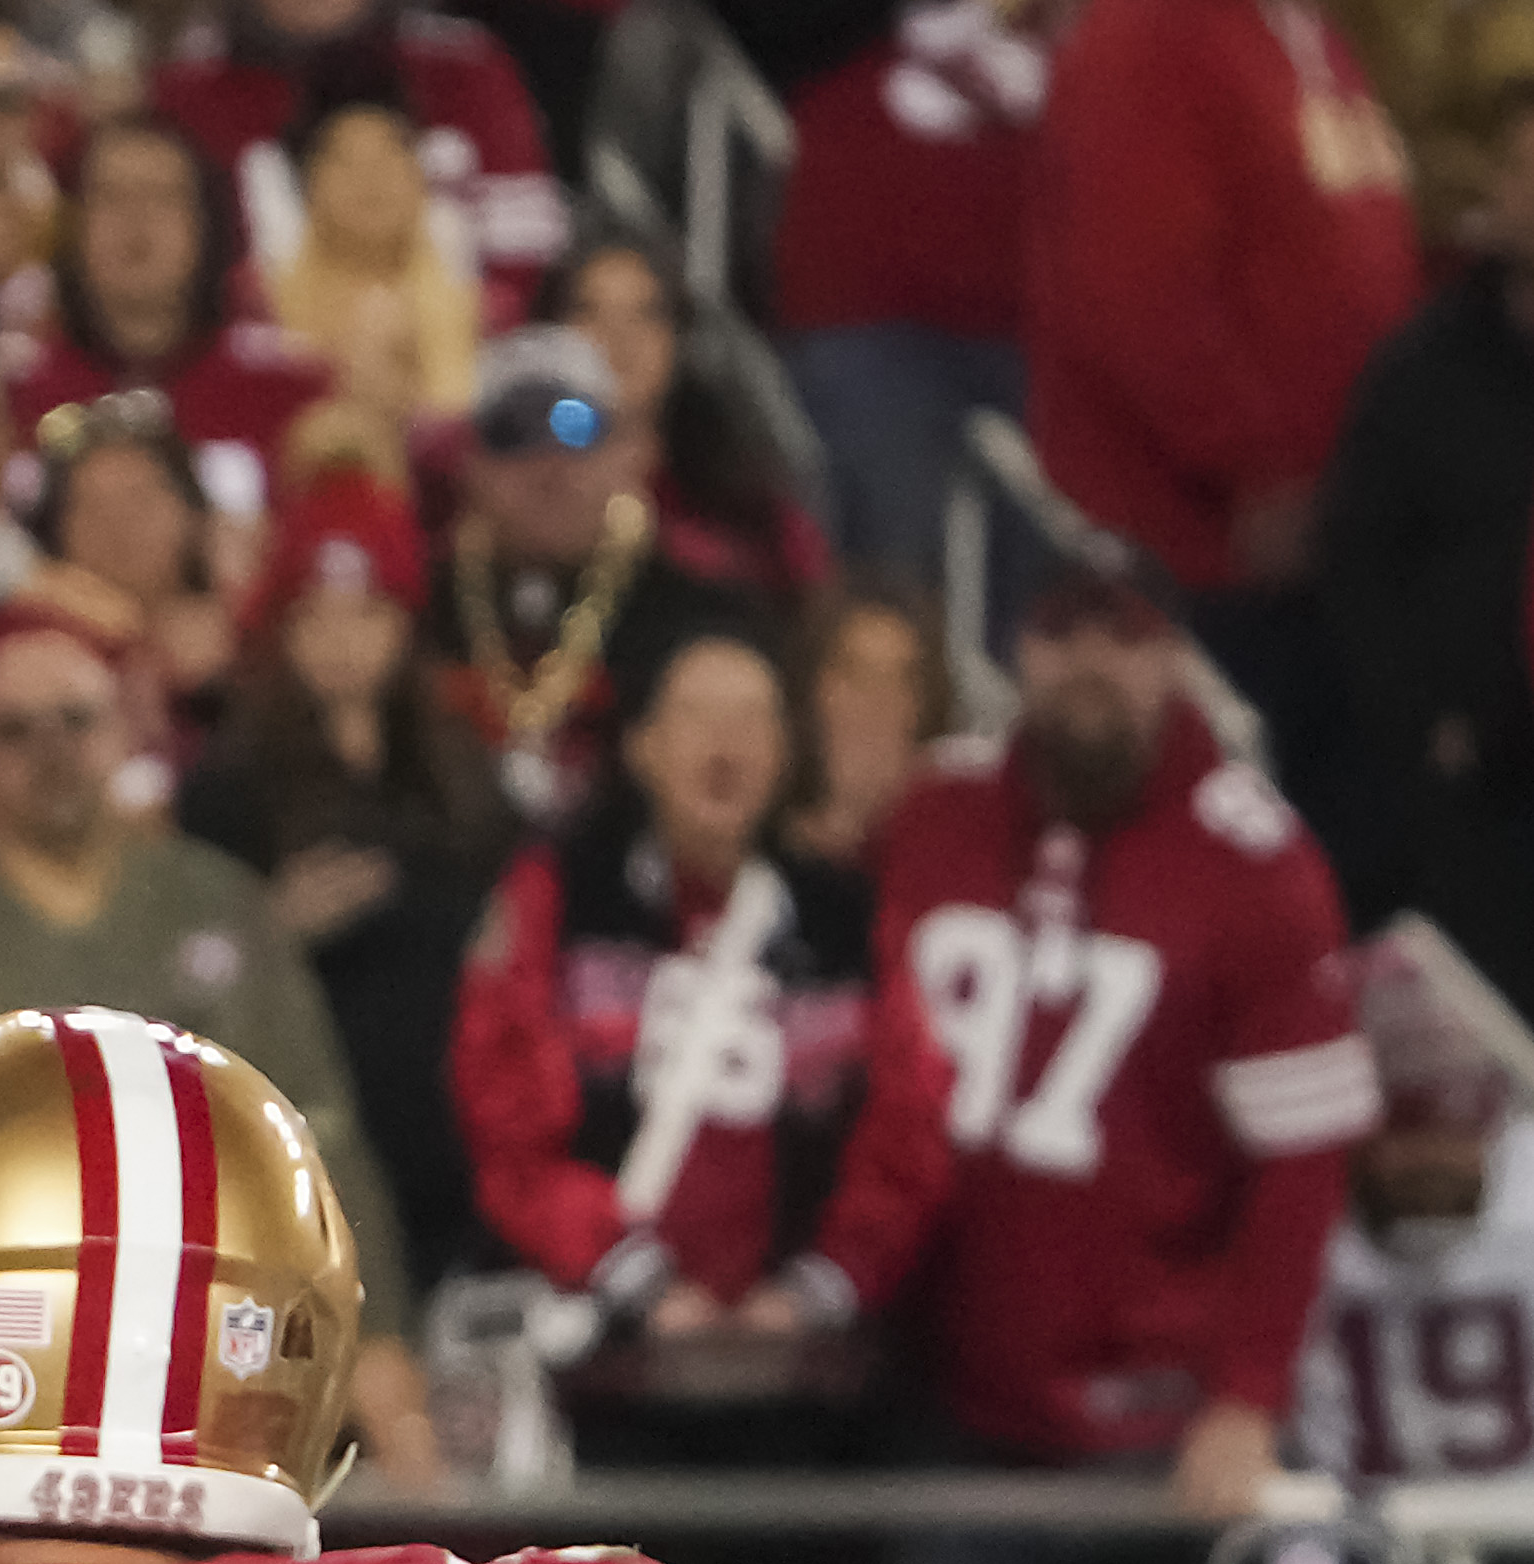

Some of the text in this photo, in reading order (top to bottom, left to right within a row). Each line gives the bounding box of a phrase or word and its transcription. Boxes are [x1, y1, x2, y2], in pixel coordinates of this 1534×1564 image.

[906, 902, 1161, 1174] 97
[1337, 1297, 1533, 1475] 19
[30, 1469, 205, 1530] 49ERS
